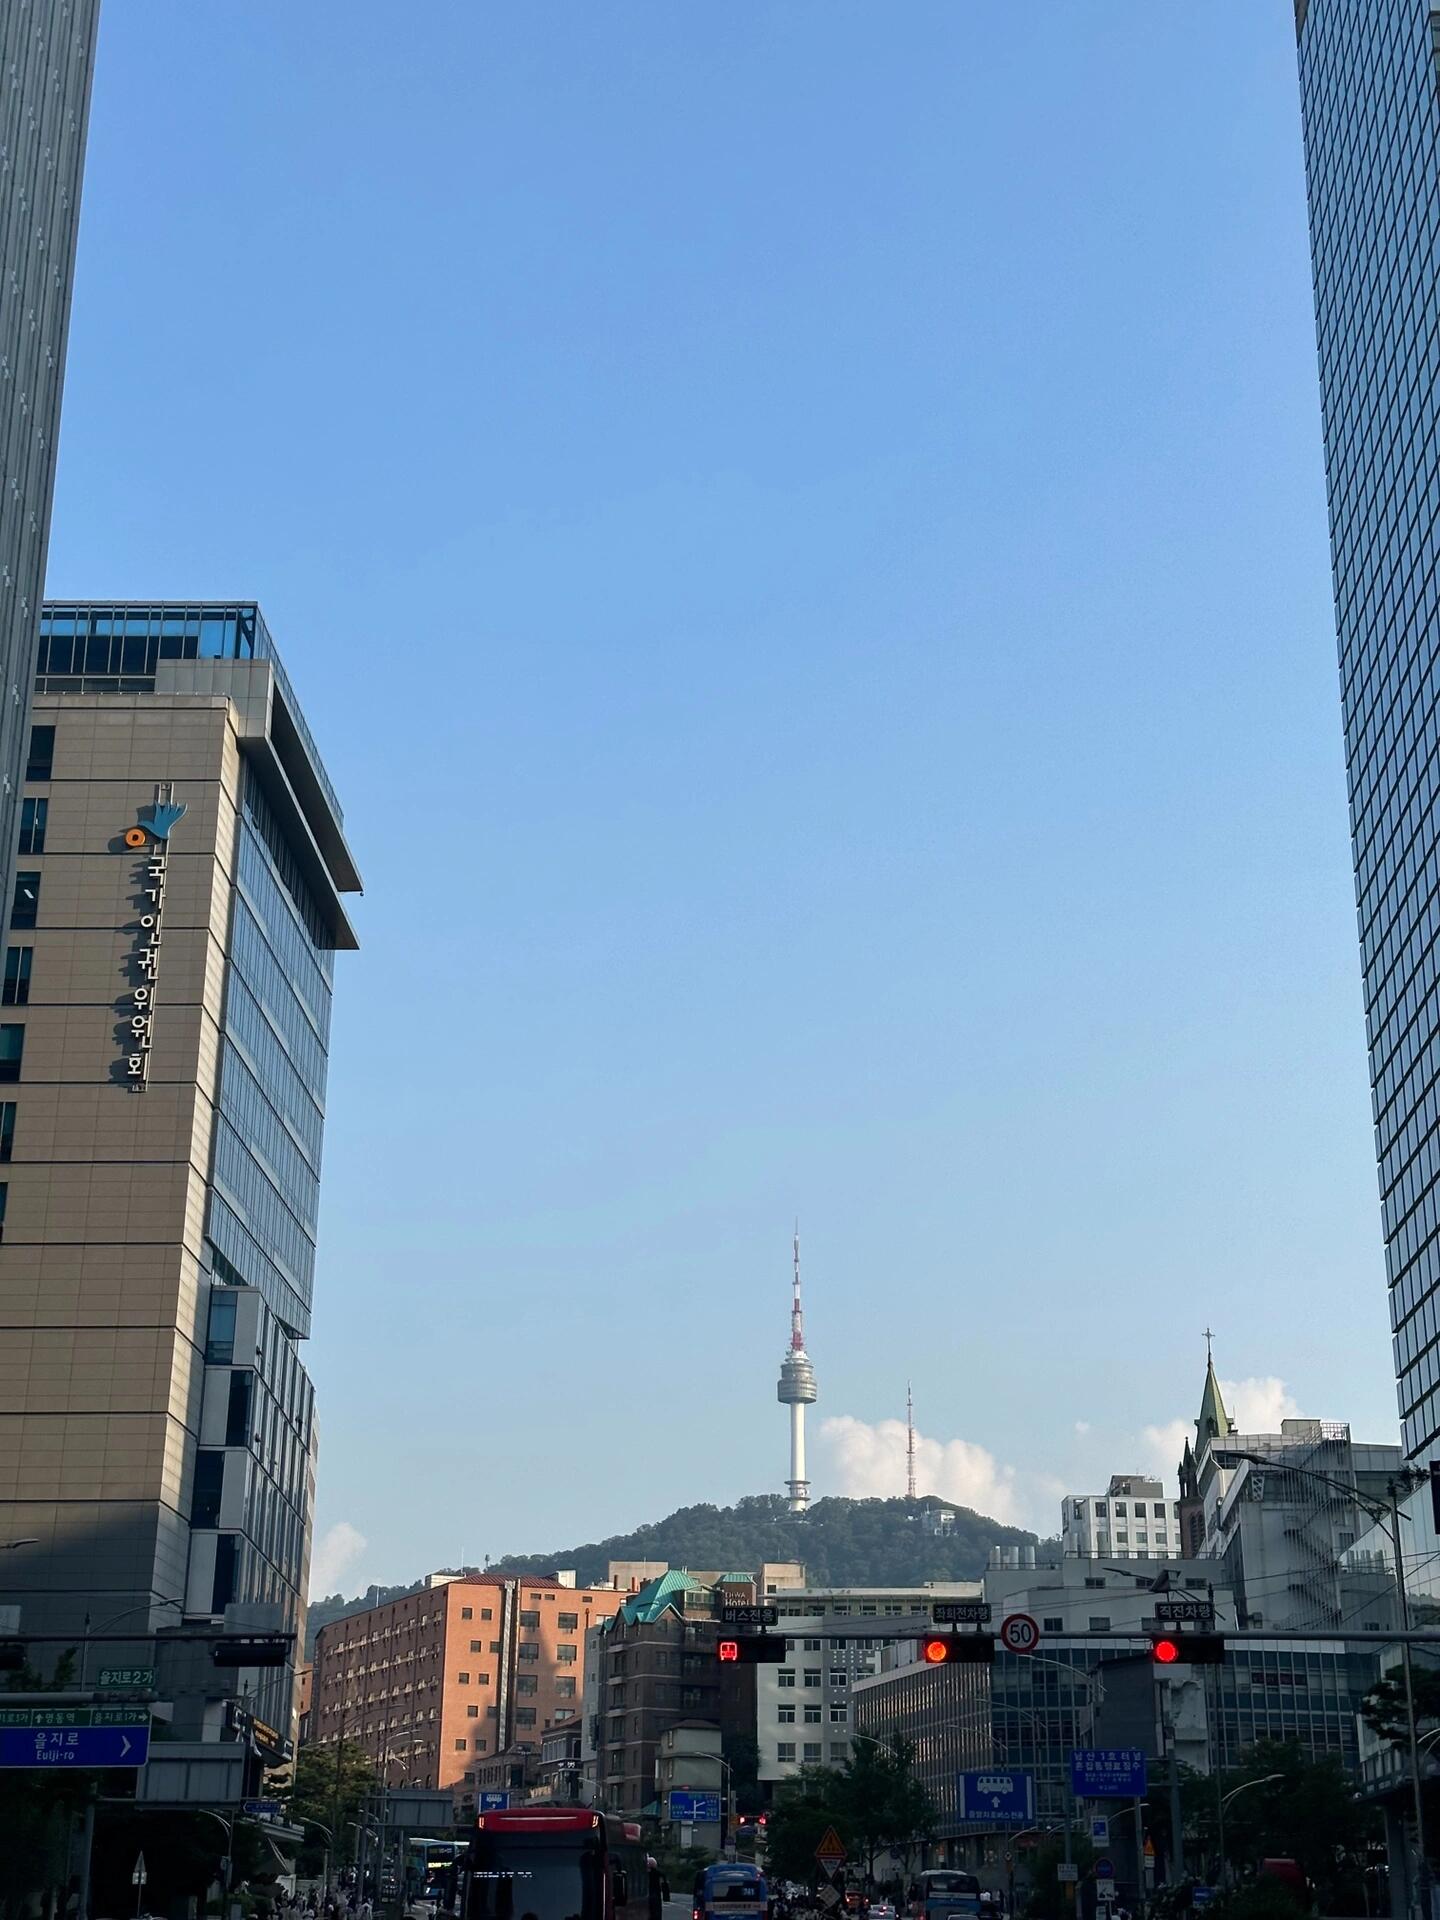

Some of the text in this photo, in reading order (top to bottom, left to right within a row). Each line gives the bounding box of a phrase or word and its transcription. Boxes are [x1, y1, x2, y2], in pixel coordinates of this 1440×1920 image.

[127, 856, 167, 1082] 국가인권위원회
[725, 1598, 750, 1607] Hotel
[725, 1608, 774, 1622] 버스전용
[1159, 1603, 1211, 1619] 직진차량
[1010, 1623, 1032, 1643] 50
[99, 1670, 153, 1685] 을지로2가
[45, 1712, 75, 1723] 명동역
[33, 1731, 80, 1750] 을지로
[36, 1750, 75, 1762] Eulji-ro
